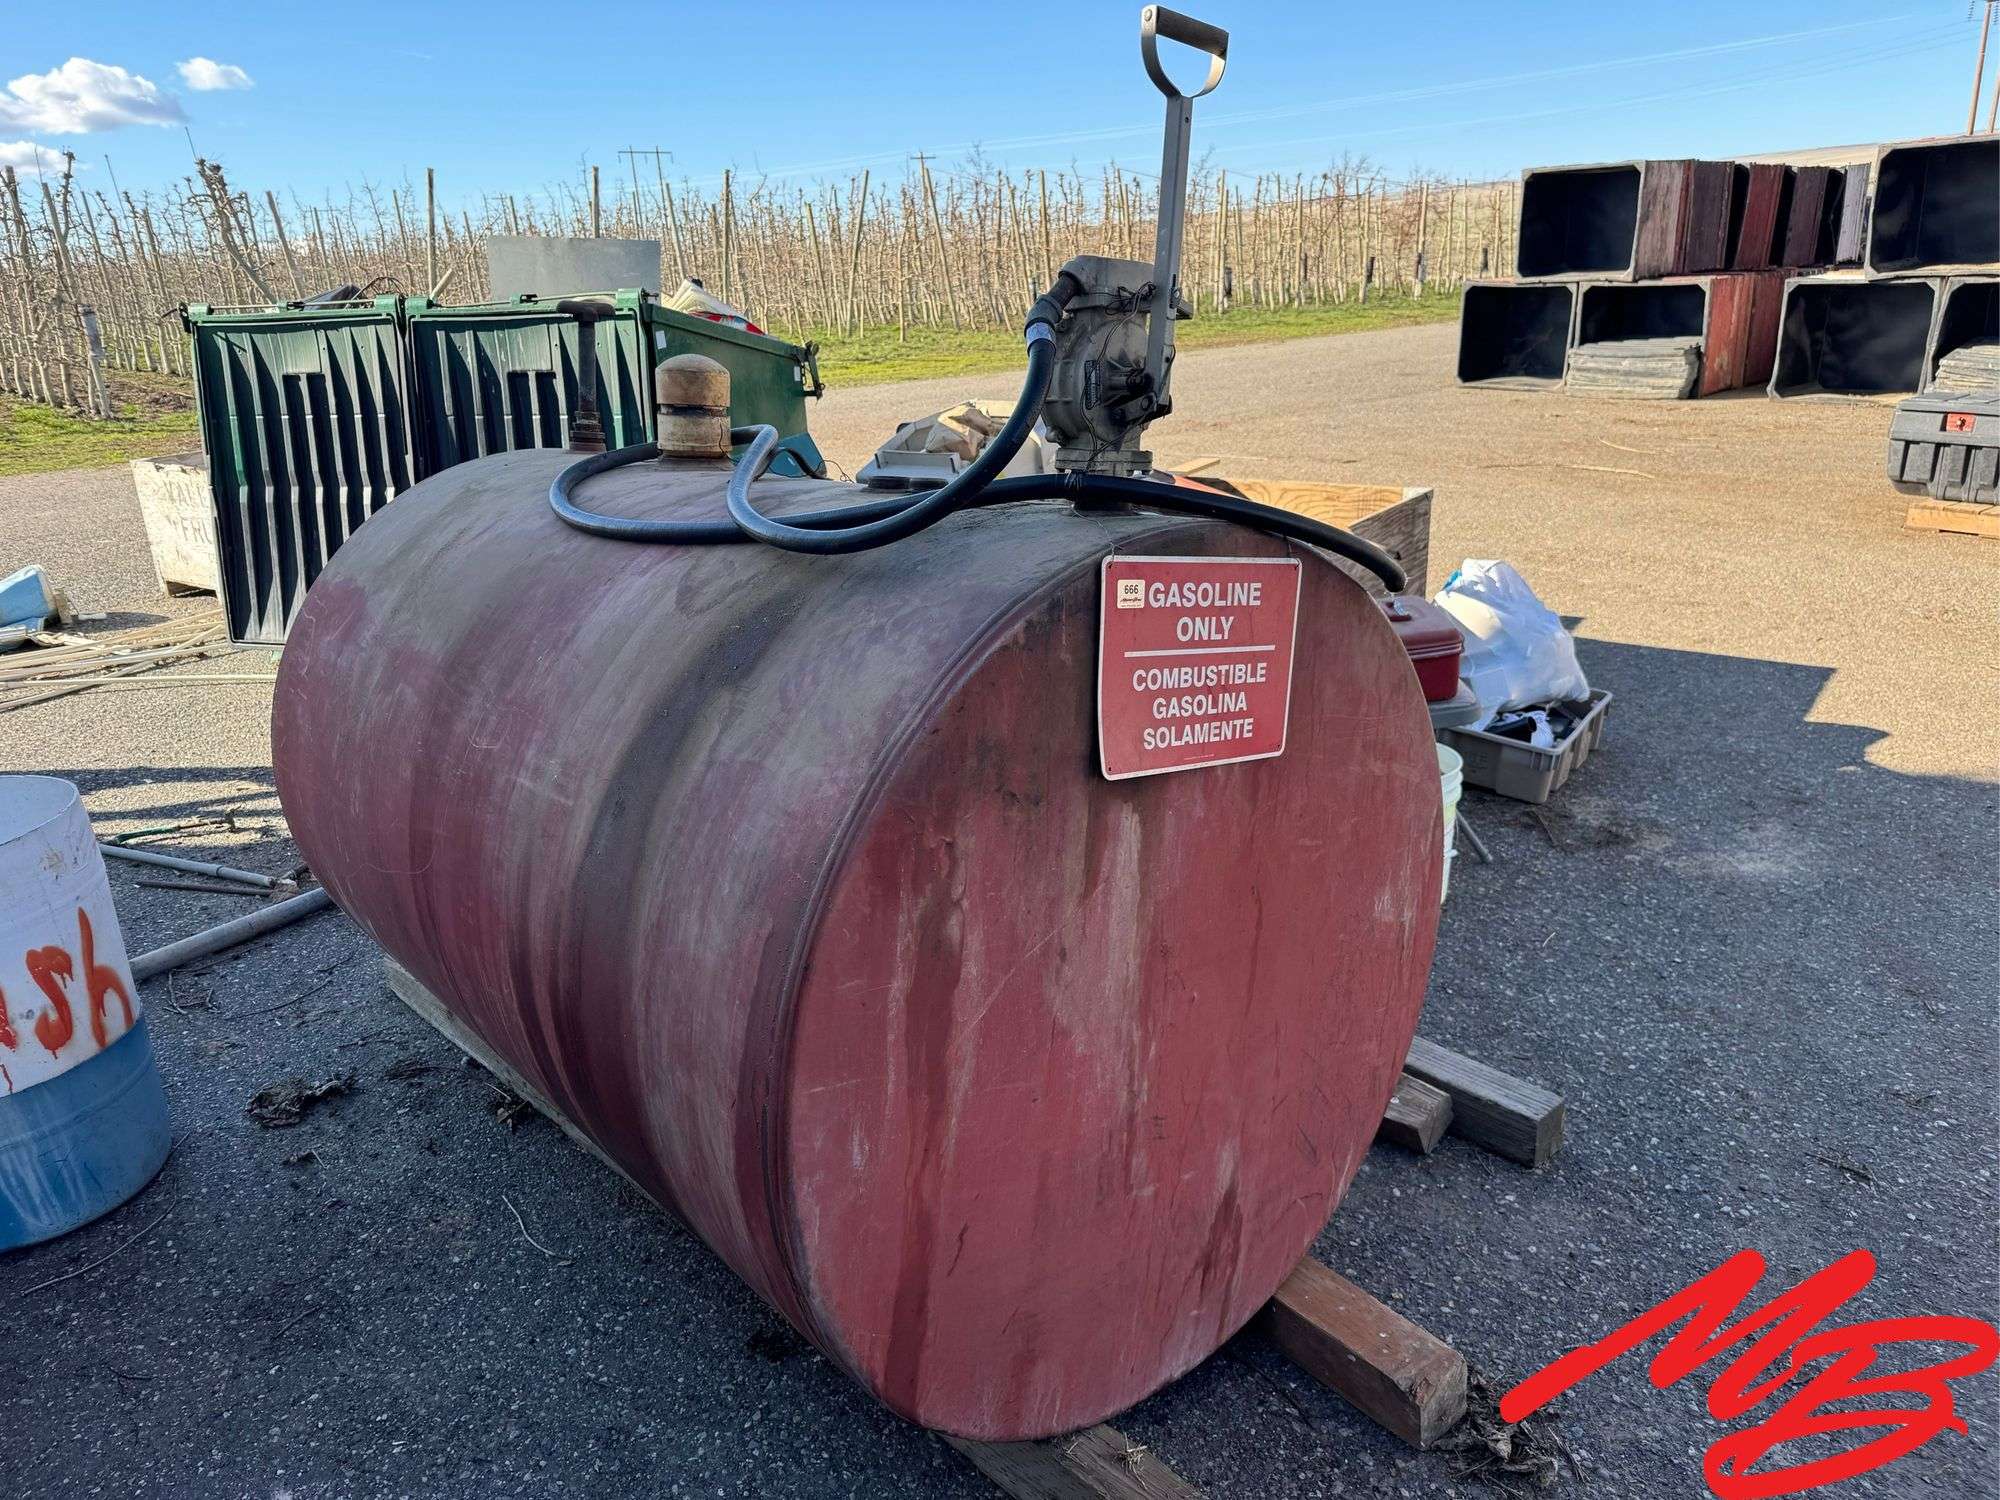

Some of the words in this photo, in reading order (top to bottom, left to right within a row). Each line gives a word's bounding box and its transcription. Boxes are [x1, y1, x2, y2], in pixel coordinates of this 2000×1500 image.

[1124, 584, 1139, 595] 666
[1149, 582, 1262, 608] GASOLINE
[1176, 615, 1234, 642] ONLY
[1132, 662, 1267, 692] COMBUSTIBLE
[1152, 691, 1247, 719] GASOLINA
[1143, 717, 1254, 750] SOLAMENTE
[0, 906, 134, 1059] sh
